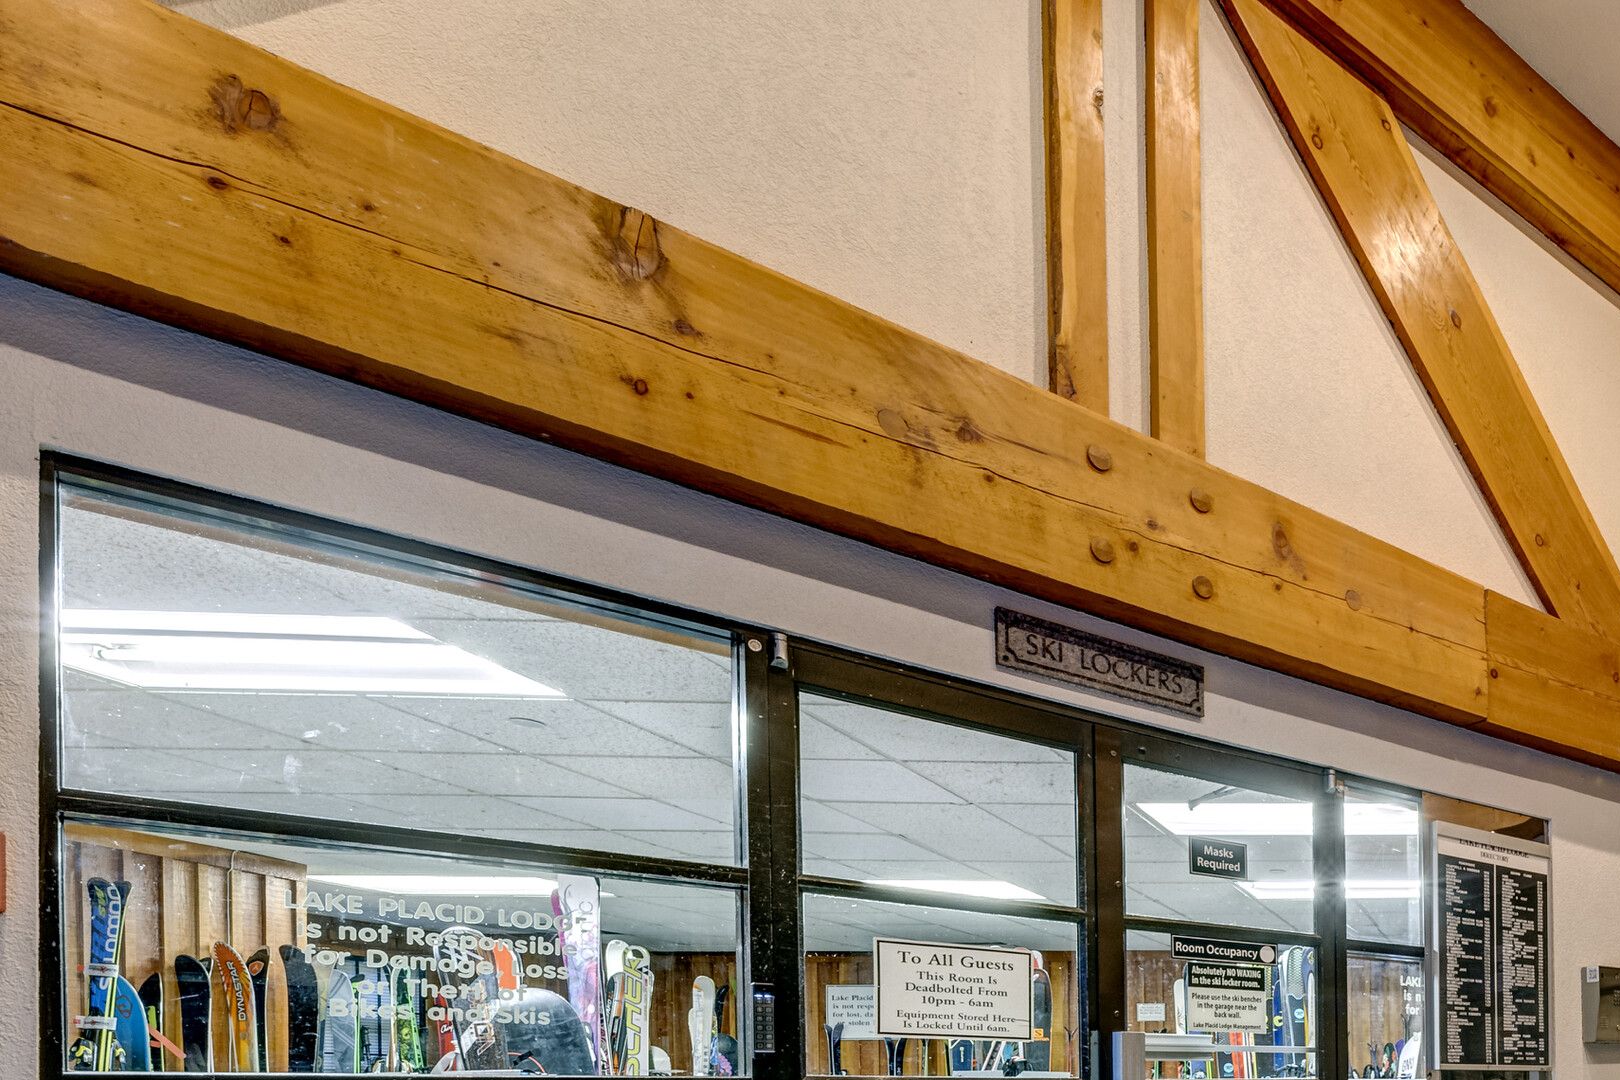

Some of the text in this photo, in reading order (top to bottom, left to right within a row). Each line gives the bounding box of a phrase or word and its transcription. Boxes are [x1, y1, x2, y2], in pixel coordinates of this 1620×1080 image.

[1026, 634, 1183, 694] SKI LOCKERS
[1204, 845, 1234, 859] Masks
[1197, 856, 1241, 872] Required
[284, 888, 364, 915] LAKE
[378, 897, 485, 925] PLACID
[297, 918, 578, 957] is not Responsible
[1175, 941, 1259, 961] Room Occupancy
[302, 943, 351, 966] for
[511, 960, 570, 981] Loss
[897, 950, 1015, 972] To All Guests
[916, 970, 998, 985] This Room Is
[1191, 965, 1262, 979] Absolutely NO WAXING
[905, 982, 1008, 997] Deadbolted From
[1191, 975, 1261, 989] in the ski locker room.
[229, 960, 248, 1022] DYNASTAR
[356, 978, 390, 996] or
[497, 984, 529, 1002] of
[1191, 992, 1211, 1001] Please
[1211, 994, 1221, 1002] use
[1221, 994, 1232, 1002] the
[1240, 995, 1262, 1003] benches
[1403, 989, 1412, 1001] is
[921, 995, 956, 1008] 10pm
[968, 999, 995, 1009] 6am
[1214, 1003, 1234, 1012] garage
[1247, 1004, 1258, 1012] the
[328, 998, 552, 1027] Bikes and Skis
[896, 1009, 1016, 1023] Equipment Stored Here
[903, 1020, 1011, 1033] Is Locked Until 6am.
